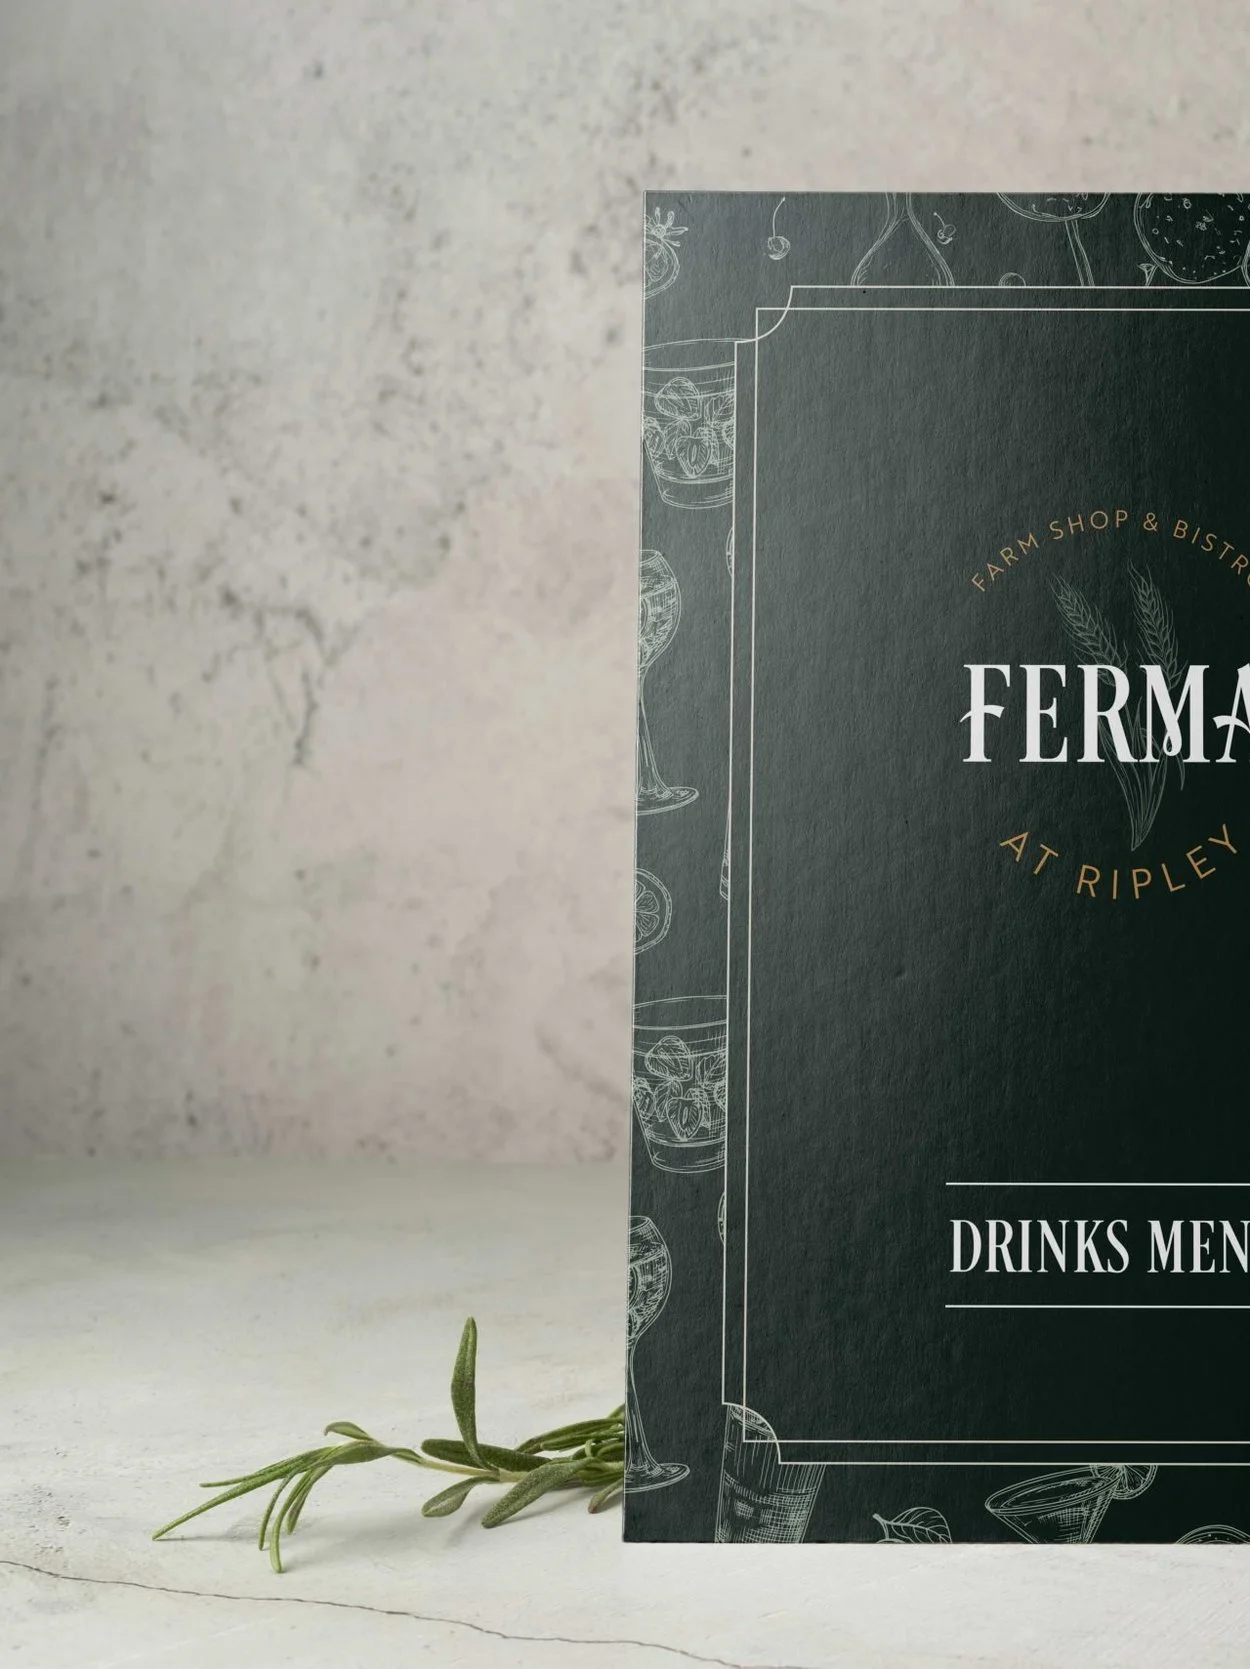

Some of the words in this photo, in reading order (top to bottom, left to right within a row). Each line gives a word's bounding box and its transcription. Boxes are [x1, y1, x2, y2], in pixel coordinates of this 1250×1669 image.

[970, 532, 1040, 592] FARM
[1049, 509, 1129, 540] SHOP
[1143, 512, 1159, 532] &
[1000, 831, 1059, 875] AT
[1076, 824, 1239, 900] RIPLEY
[950, 1219, 1130, 1273] DRINKS
